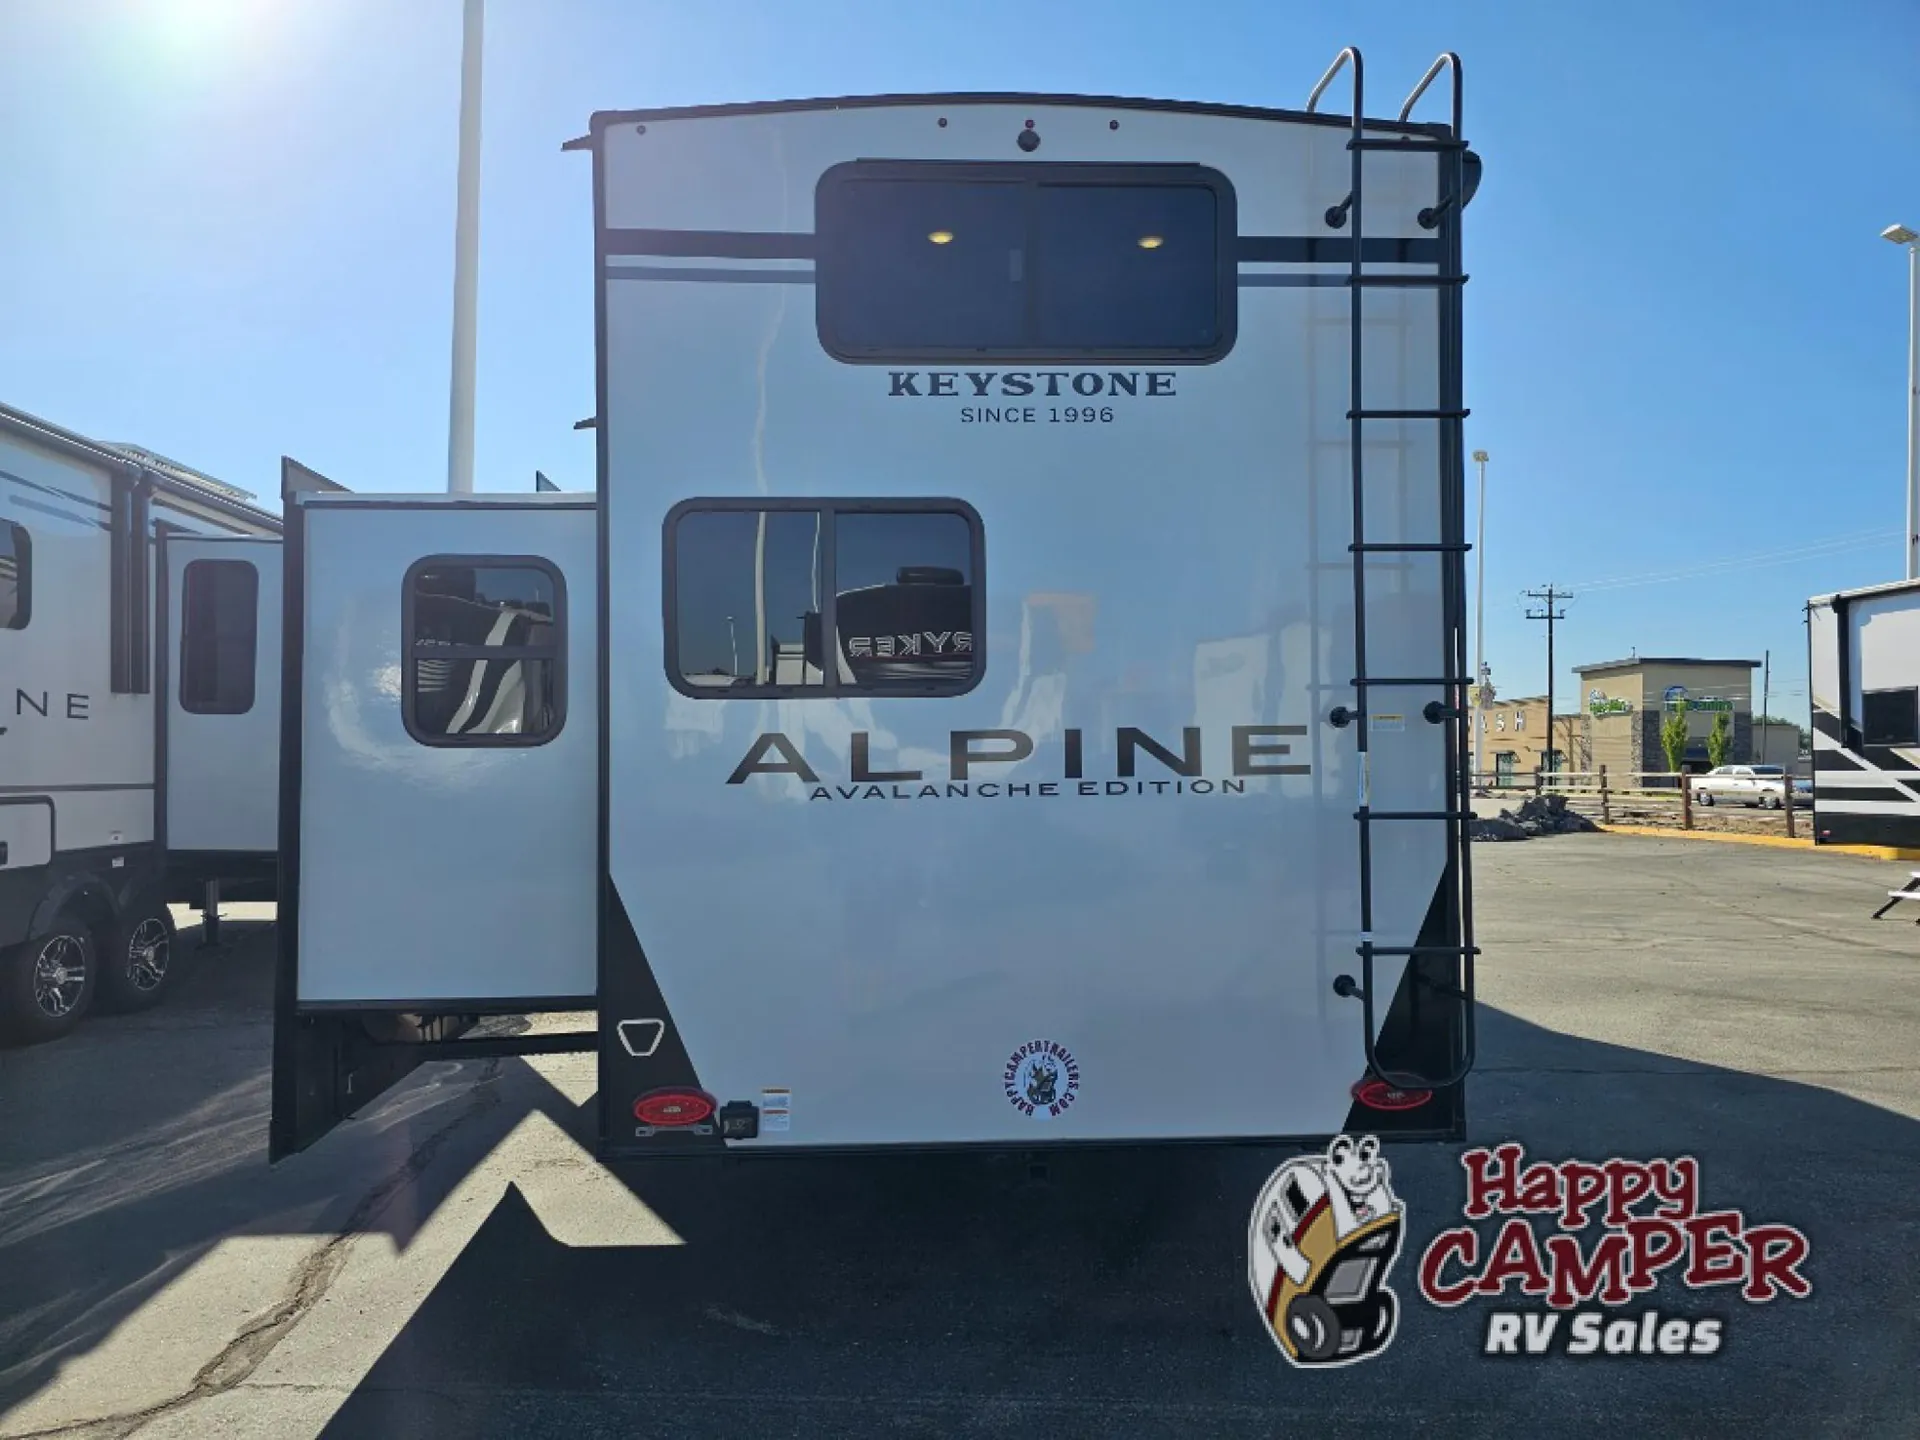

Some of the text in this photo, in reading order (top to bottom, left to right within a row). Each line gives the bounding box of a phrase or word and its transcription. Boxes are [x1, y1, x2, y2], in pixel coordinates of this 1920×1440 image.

[888, 371, 1177, 397] KEYSTONE
[960, 406, 1115, 424] SINCE 1996
[725, 725, 1312, 785] ALPINE
[810, 777, 1246, 801] AVALANCHE EDITION
